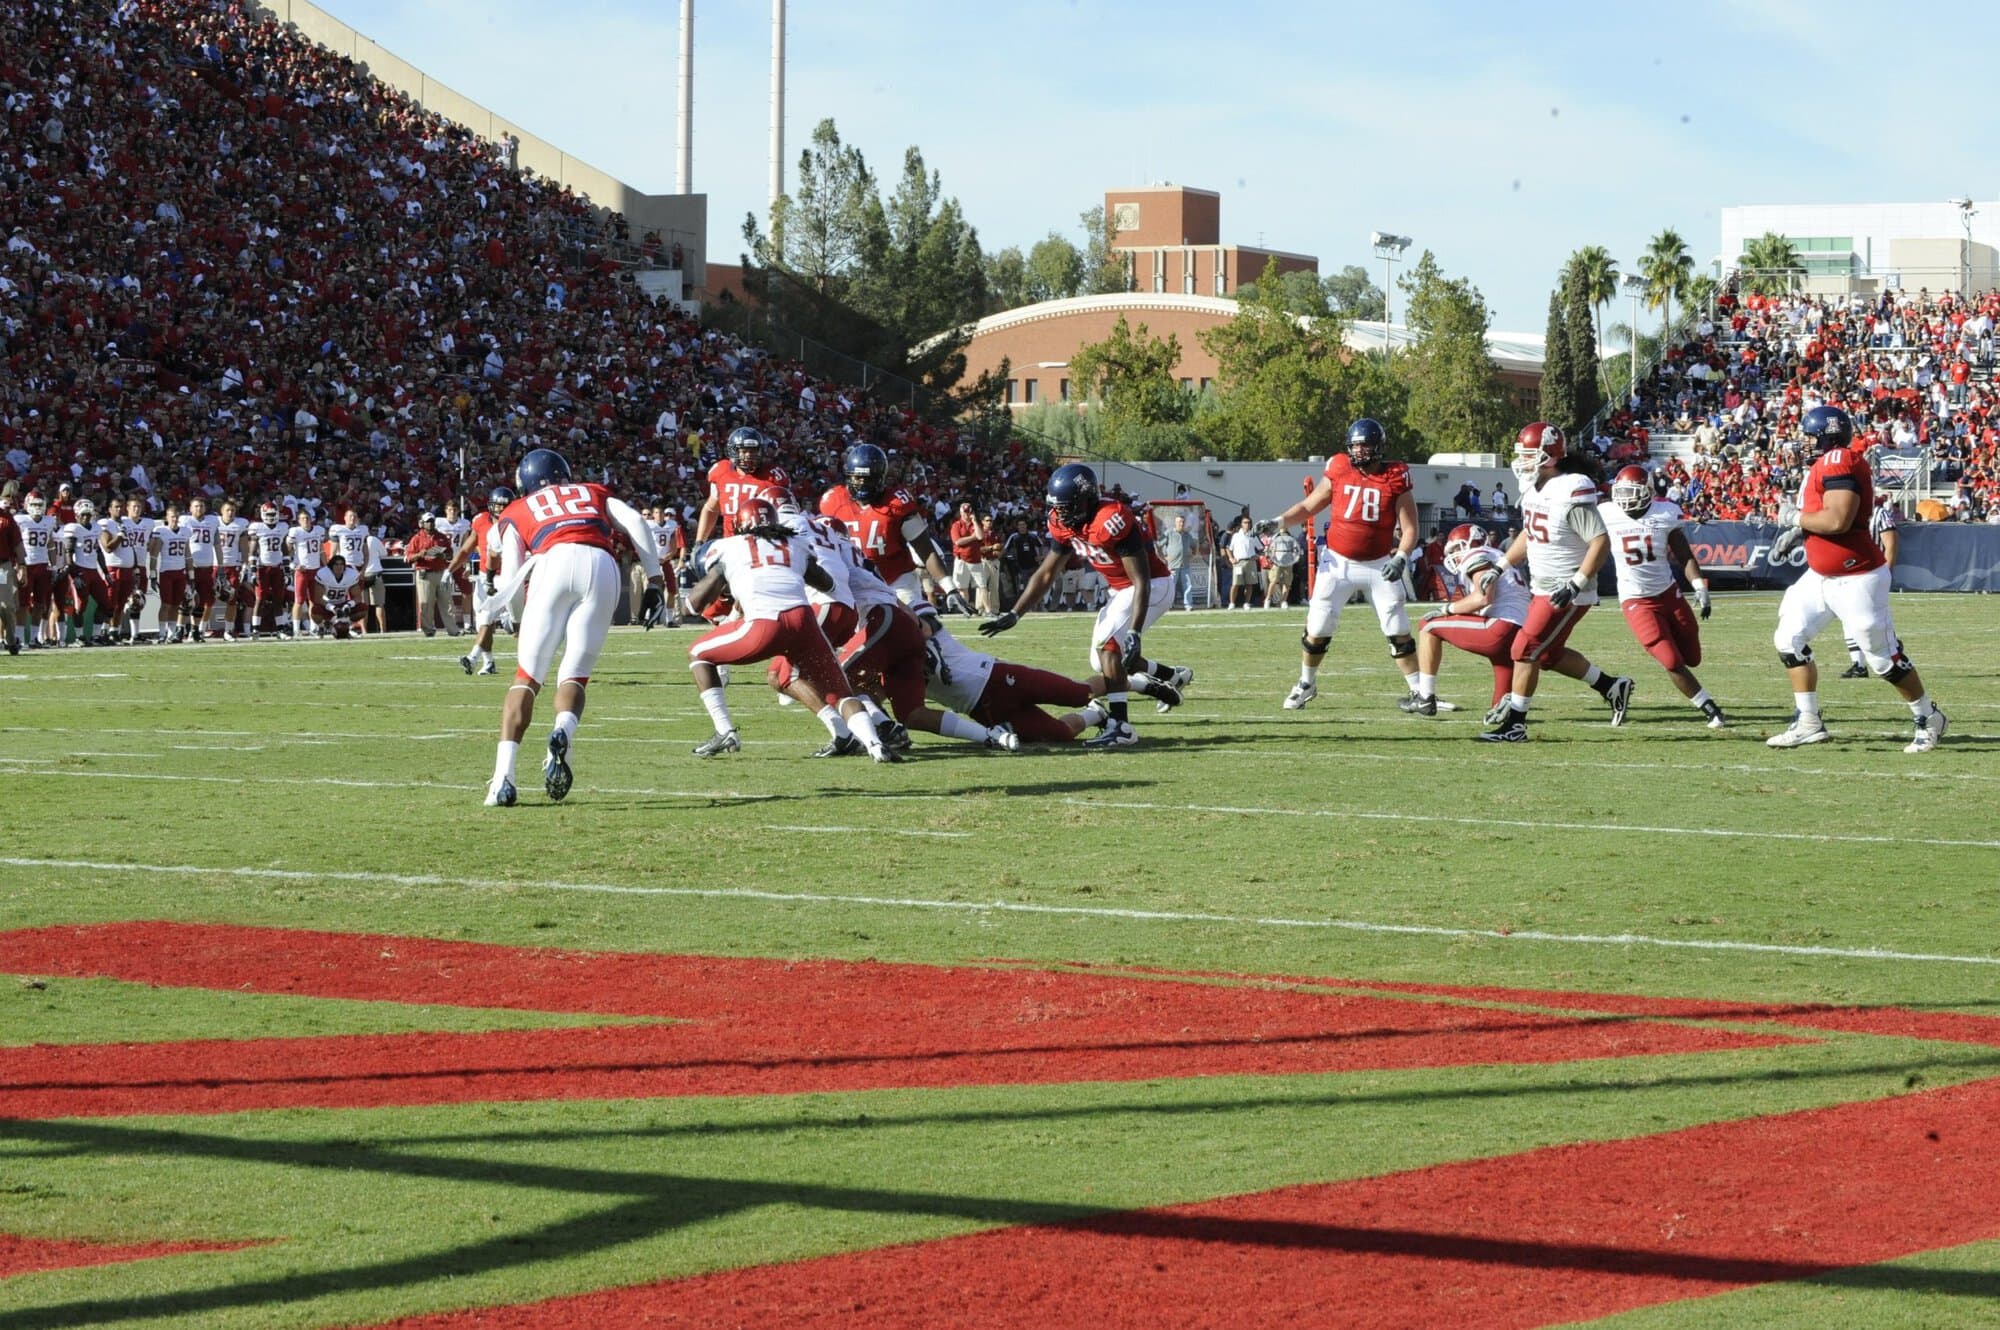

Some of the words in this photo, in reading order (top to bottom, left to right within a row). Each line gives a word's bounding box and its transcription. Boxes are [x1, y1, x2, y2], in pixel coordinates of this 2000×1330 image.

[526, 484, 599, 522] 82
[724, 482, 759, 515] 37
[1343, 484, 1381, 522] 78
[192, 528, 212, 544] 78
[1103, 512, 1126, 537] 88
[28, 531, 48, 548] 83
[266, 537, 281, 552] 12
[306, 539, 319, 554] 13
[658, 534, 667, 547] 8
[744, 534, 792, 570] 13
[1622, 534, 1657, 566] 51
